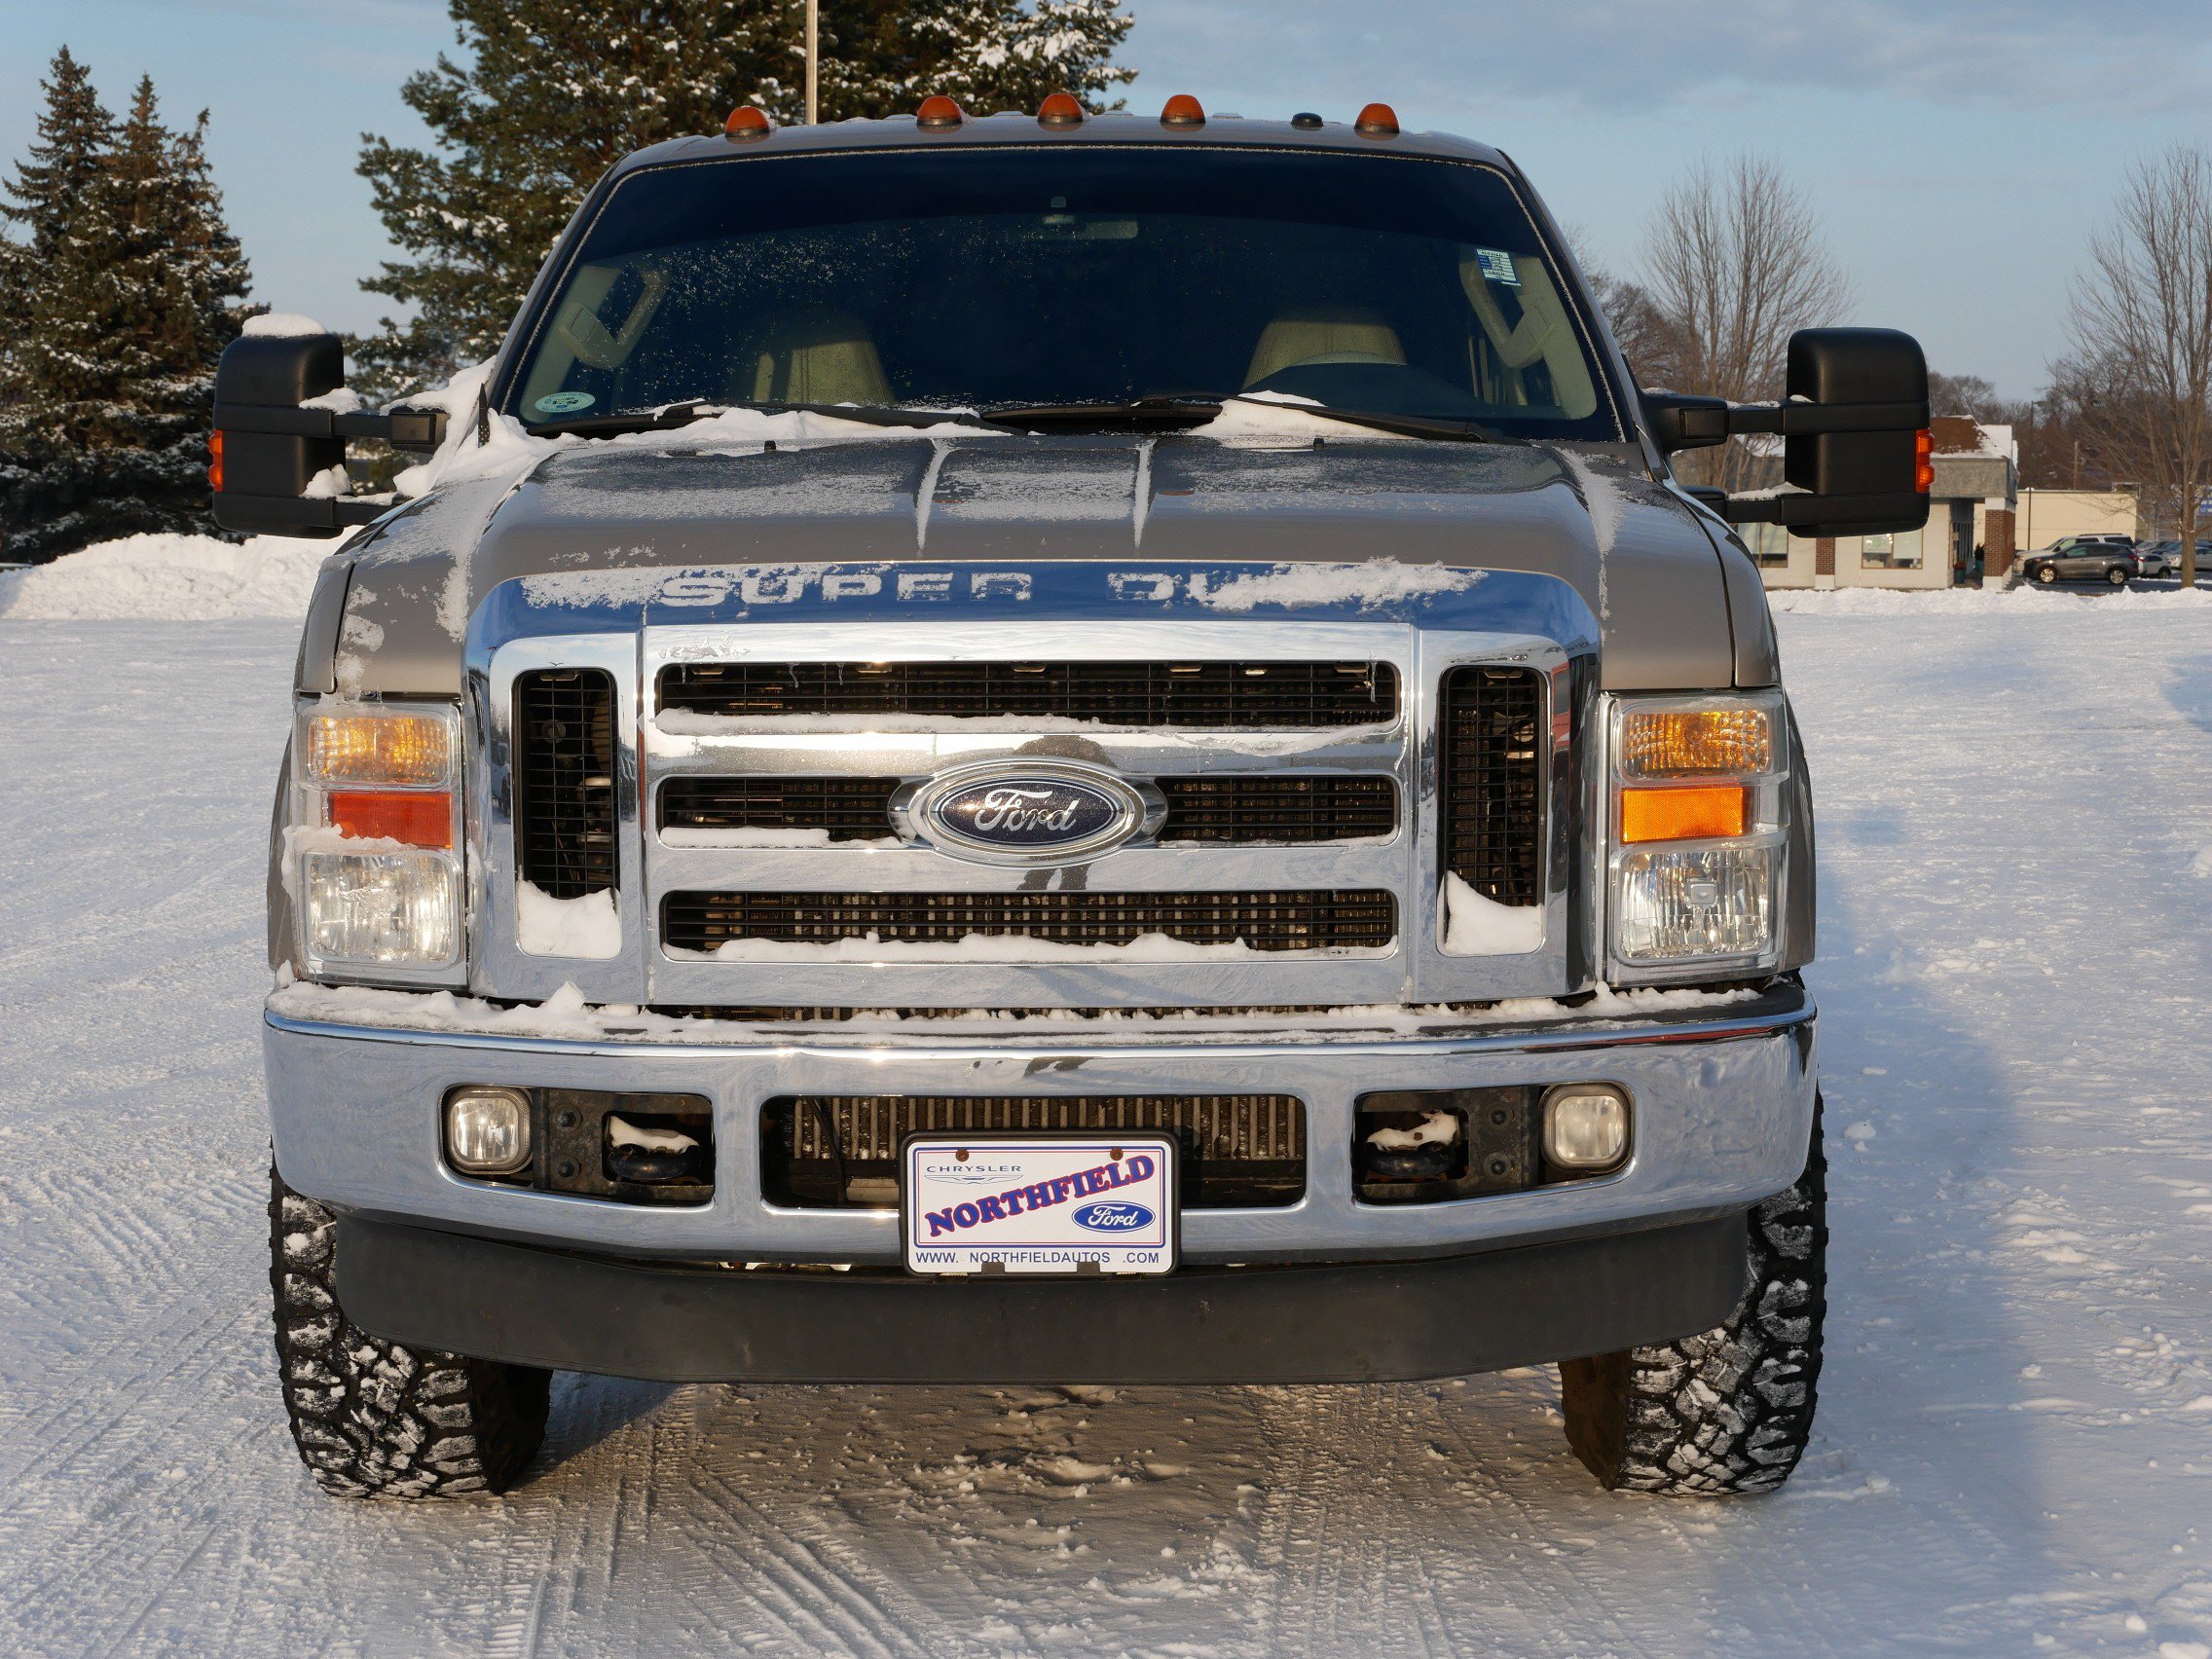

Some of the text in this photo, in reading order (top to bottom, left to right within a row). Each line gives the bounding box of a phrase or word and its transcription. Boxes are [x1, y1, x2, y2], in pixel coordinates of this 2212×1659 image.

[658, 571, 1032, 607] SUPER
[975, 788, 1080, 832] Ford
[926, 1164, 1022, 1173] CHRYSLER
[924, 1155, 1156, 1237] NORTHFIELD
[1088, 1205, 1139, 1227] Ford
[915, 1251, 1160, 1264] WWW. NORTHFIELDAUTOS .COM
